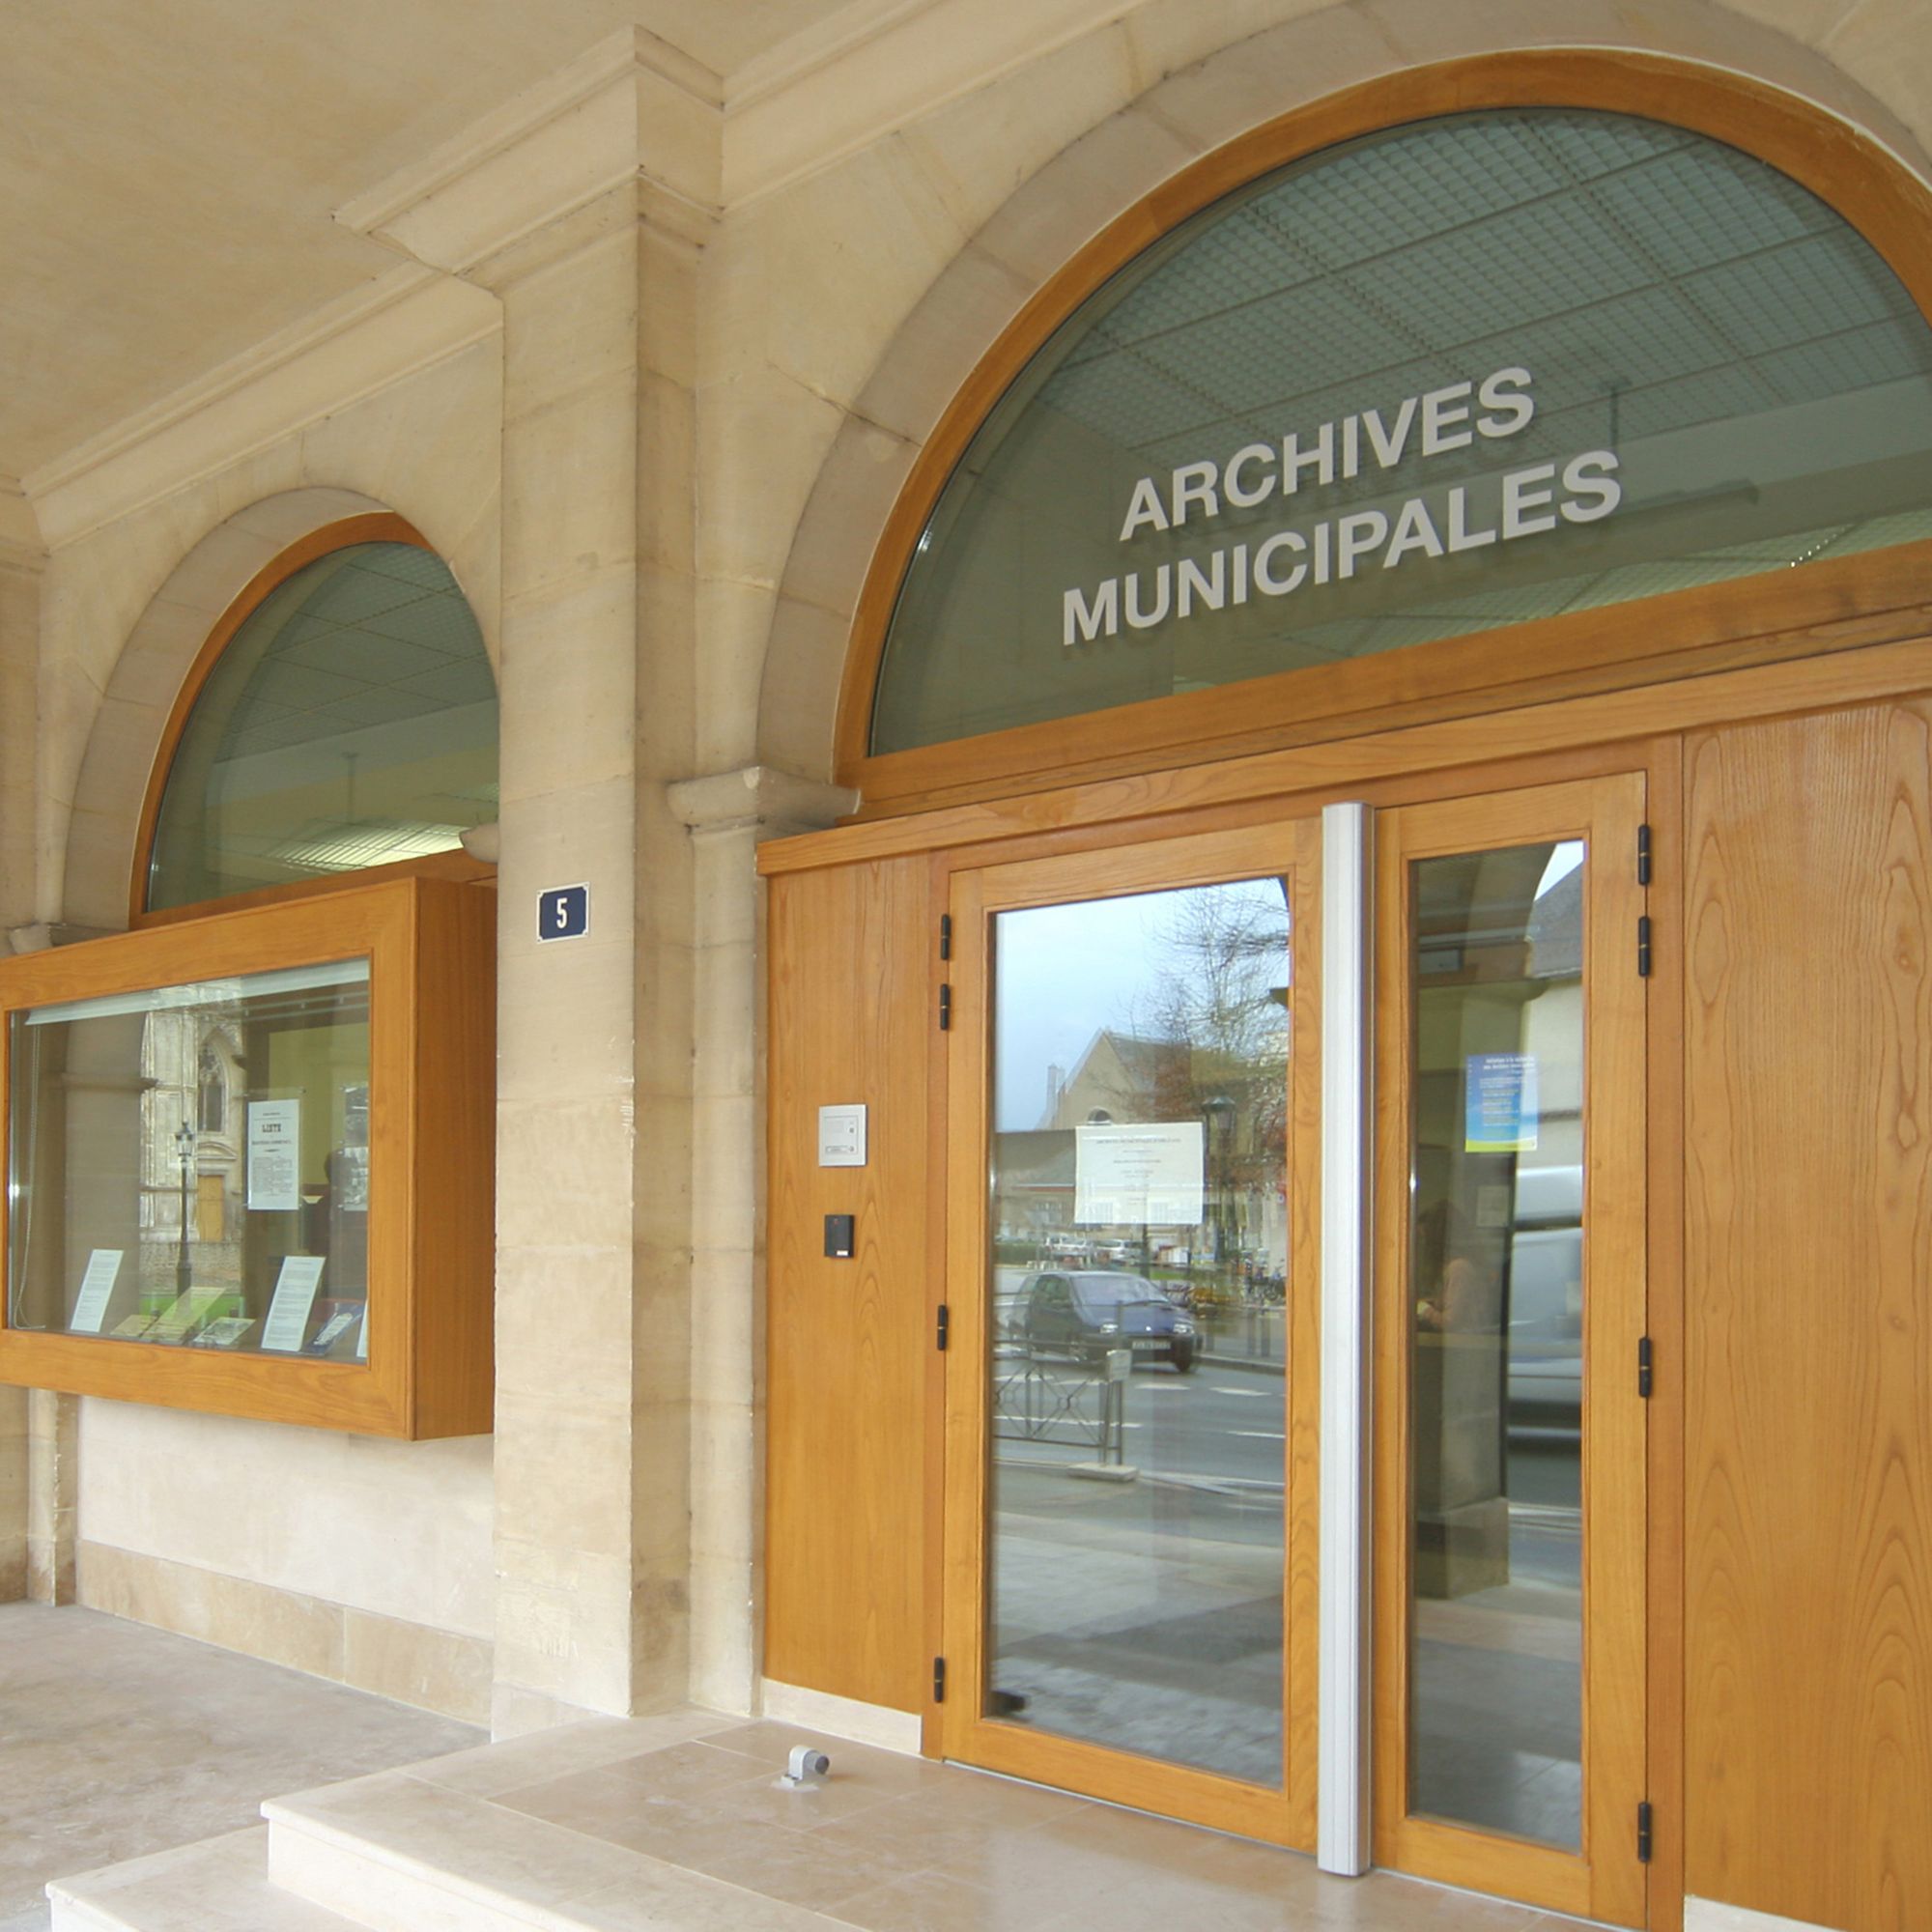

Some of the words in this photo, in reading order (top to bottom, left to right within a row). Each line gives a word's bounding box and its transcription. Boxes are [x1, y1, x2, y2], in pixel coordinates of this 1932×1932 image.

[1119, 366, 1534, 541] ARCHIVES
[1064, 449, 1621, 645] MUNICIPALES
[556, 897, 567, 928] 5
